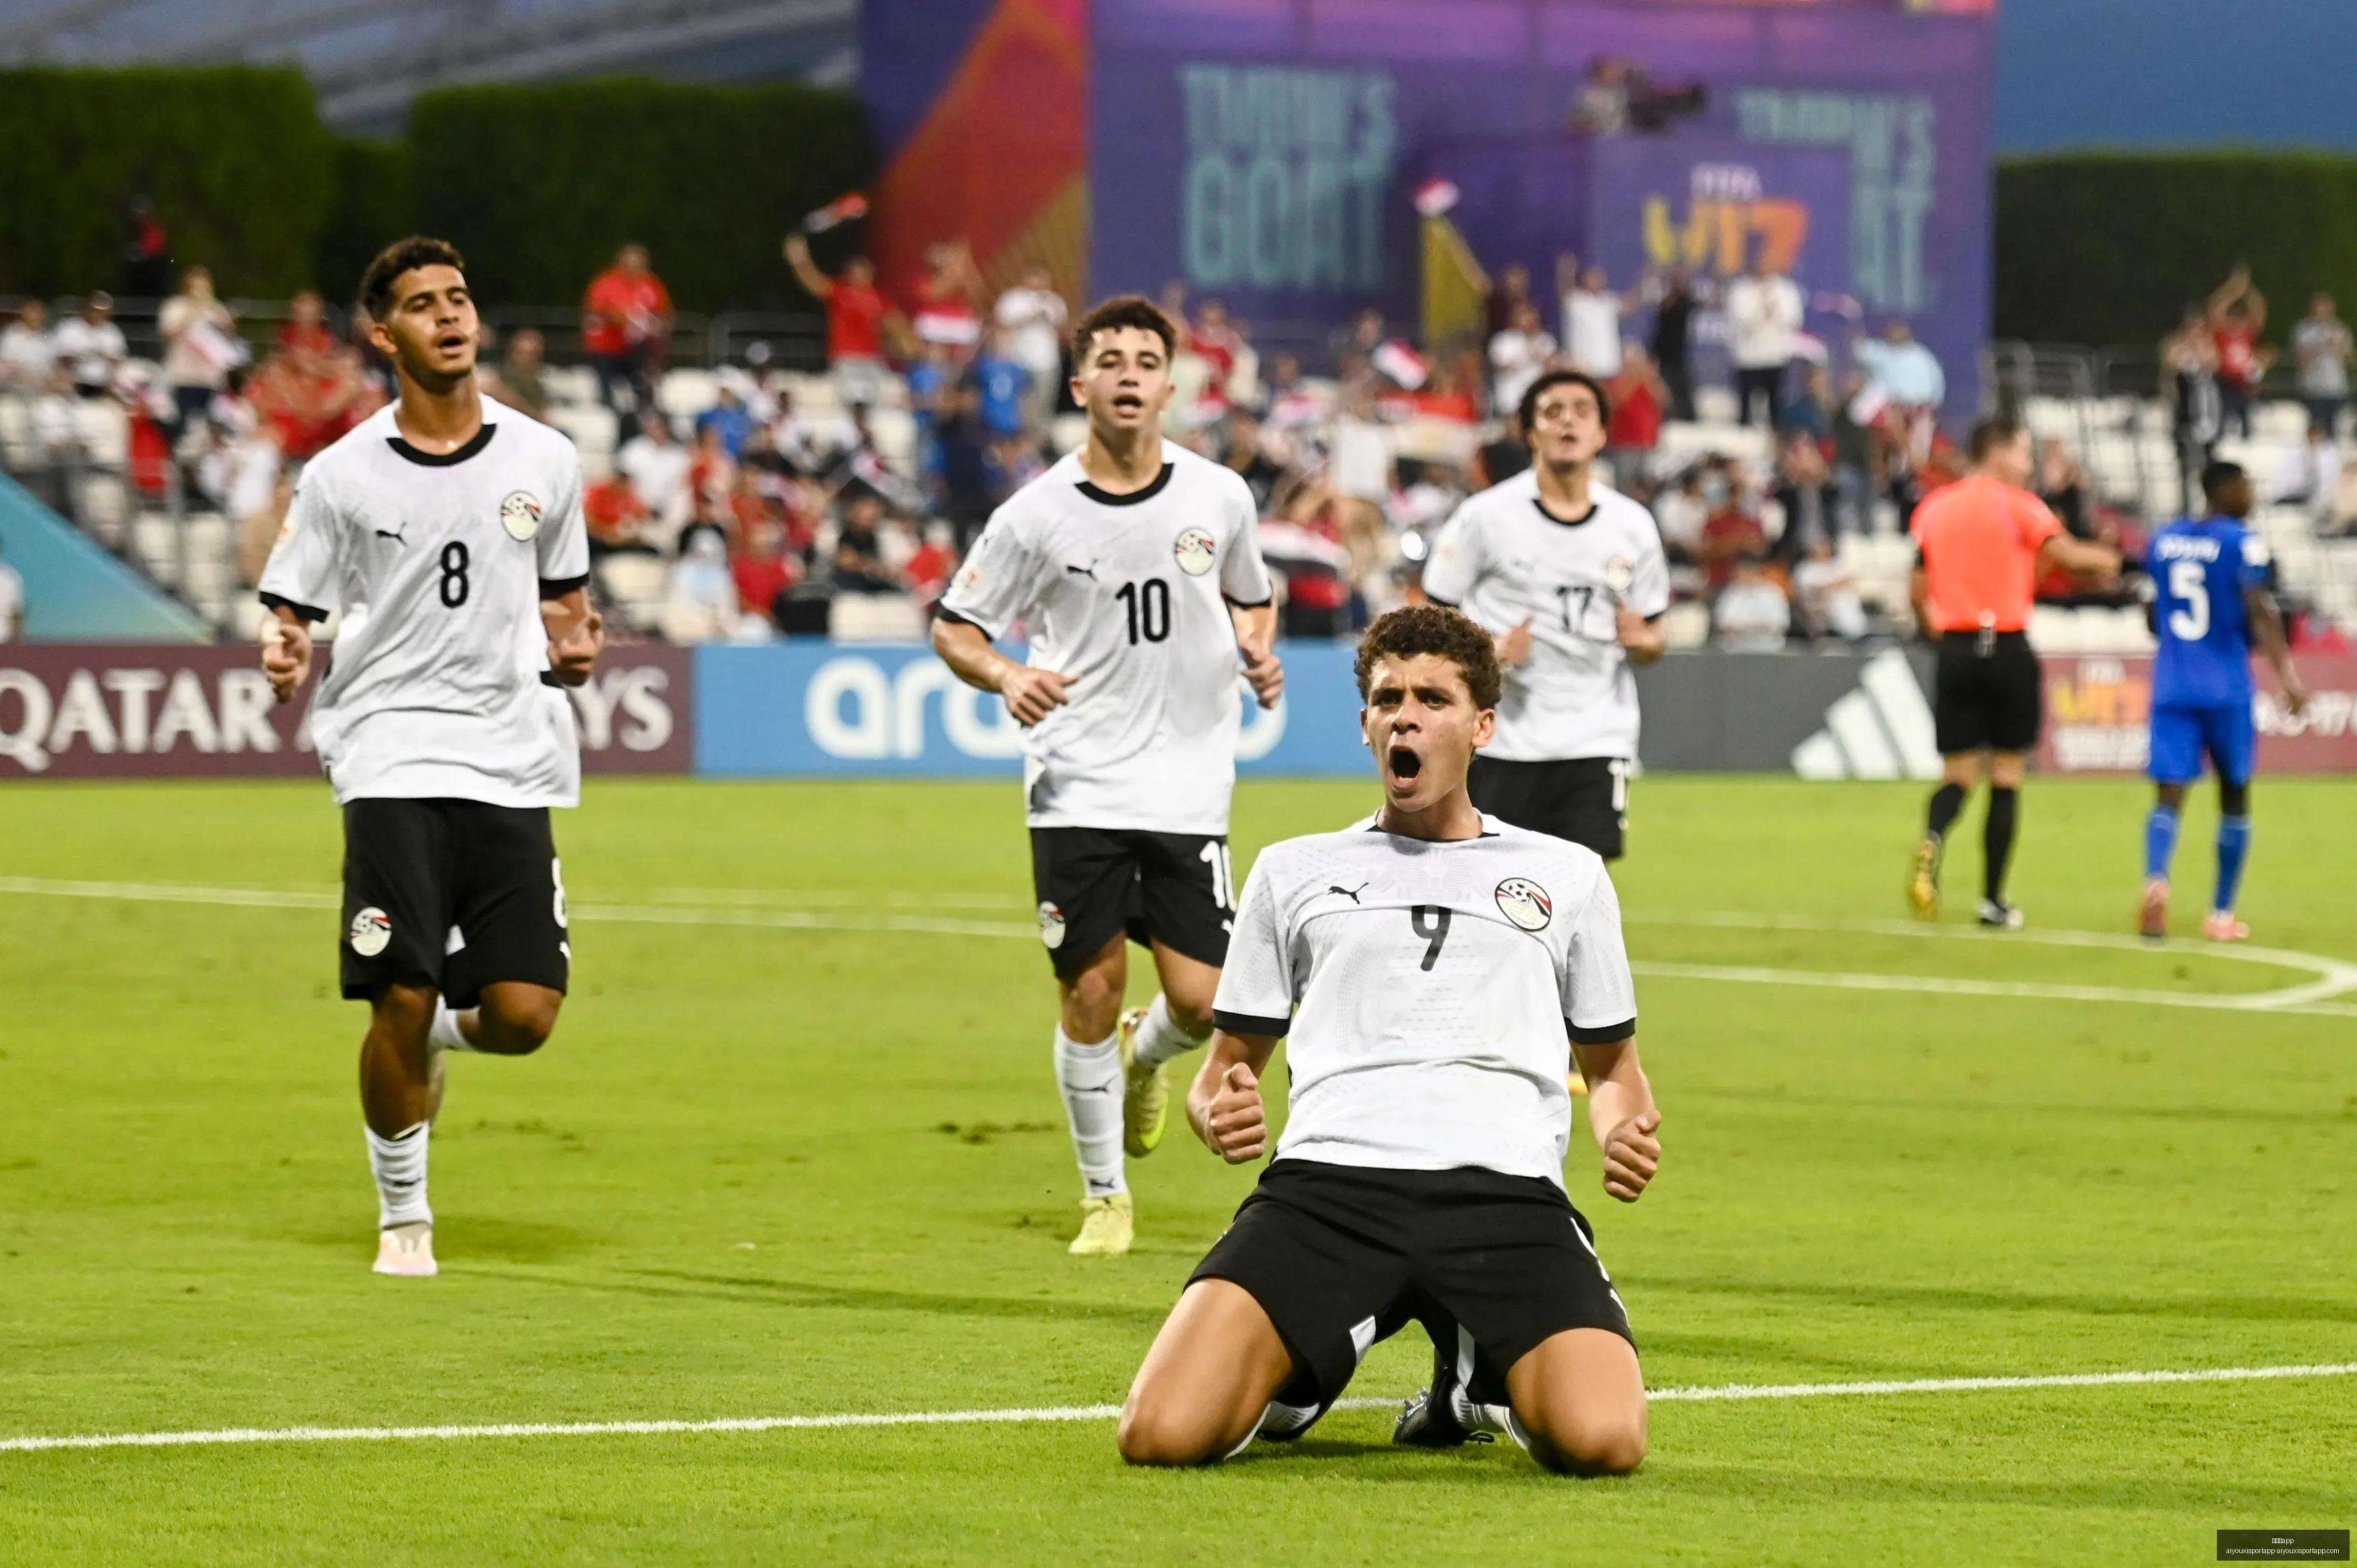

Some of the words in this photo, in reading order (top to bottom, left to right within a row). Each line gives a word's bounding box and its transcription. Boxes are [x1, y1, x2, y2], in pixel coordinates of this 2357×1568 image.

[440, 541, 469, 609] 8
[2168, 560, 2210, 641] 5
[1115, 578, 1170, 646] 10
[1554, 585, 1594, 634] 17
[0, 667, 281, 772] QATAR
[1412, 904, 1452, 972] 9
